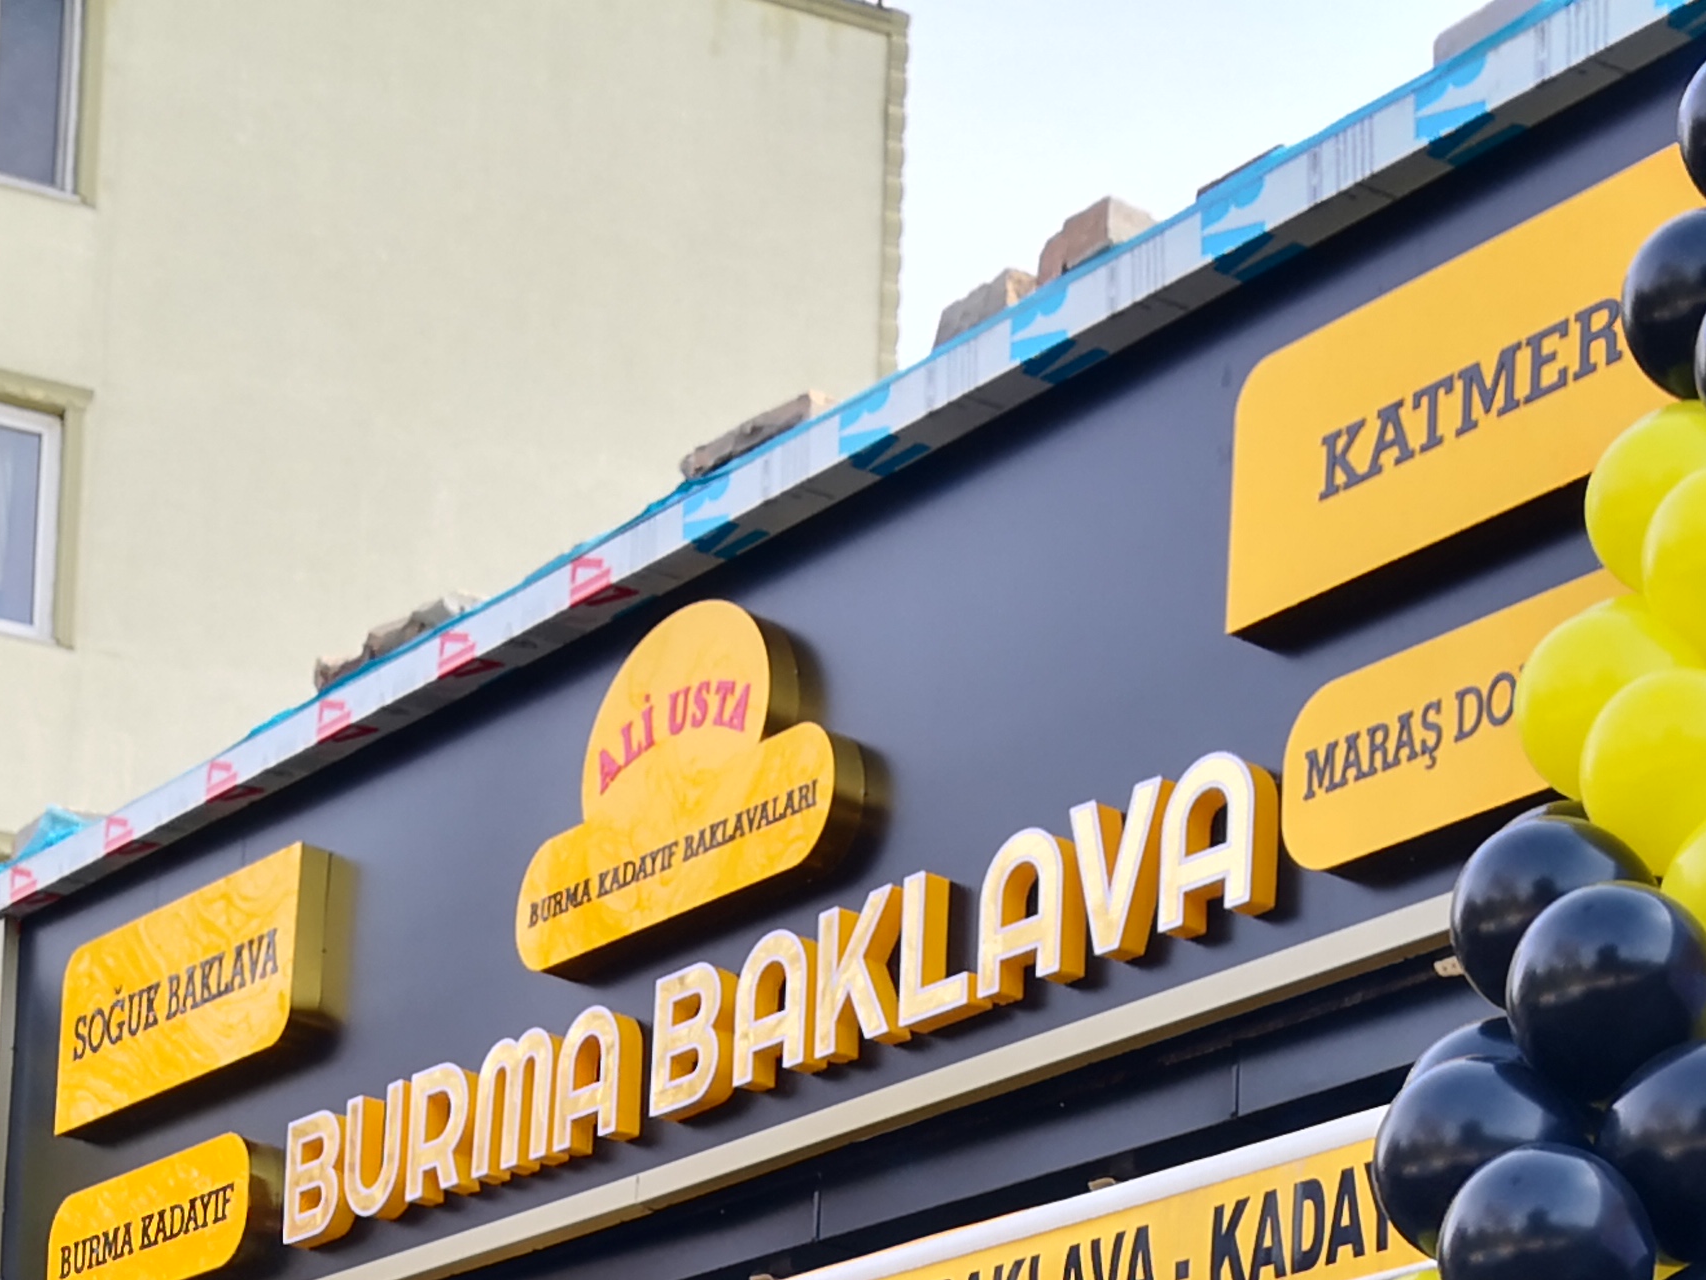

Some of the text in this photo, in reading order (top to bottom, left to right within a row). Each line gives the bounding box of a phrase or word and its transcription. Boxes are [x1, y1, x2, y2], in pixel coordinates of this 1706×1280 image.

[1318, 297, 1623, 502] KATMER
[597, 677, 753, 795] ALİ USTA
[1303, 664, 1524, 801] MARAŞ DO
[528, 778, 820, 929] BURMA KADAYIF BAKLAVALARI
[72, 928, 280, 1062] SOĞUK BAKLAVA
[283, 751, 1265, 1247] BURMA BAKLAVA
[139, 1182, 236, 1249] KADAYIF
